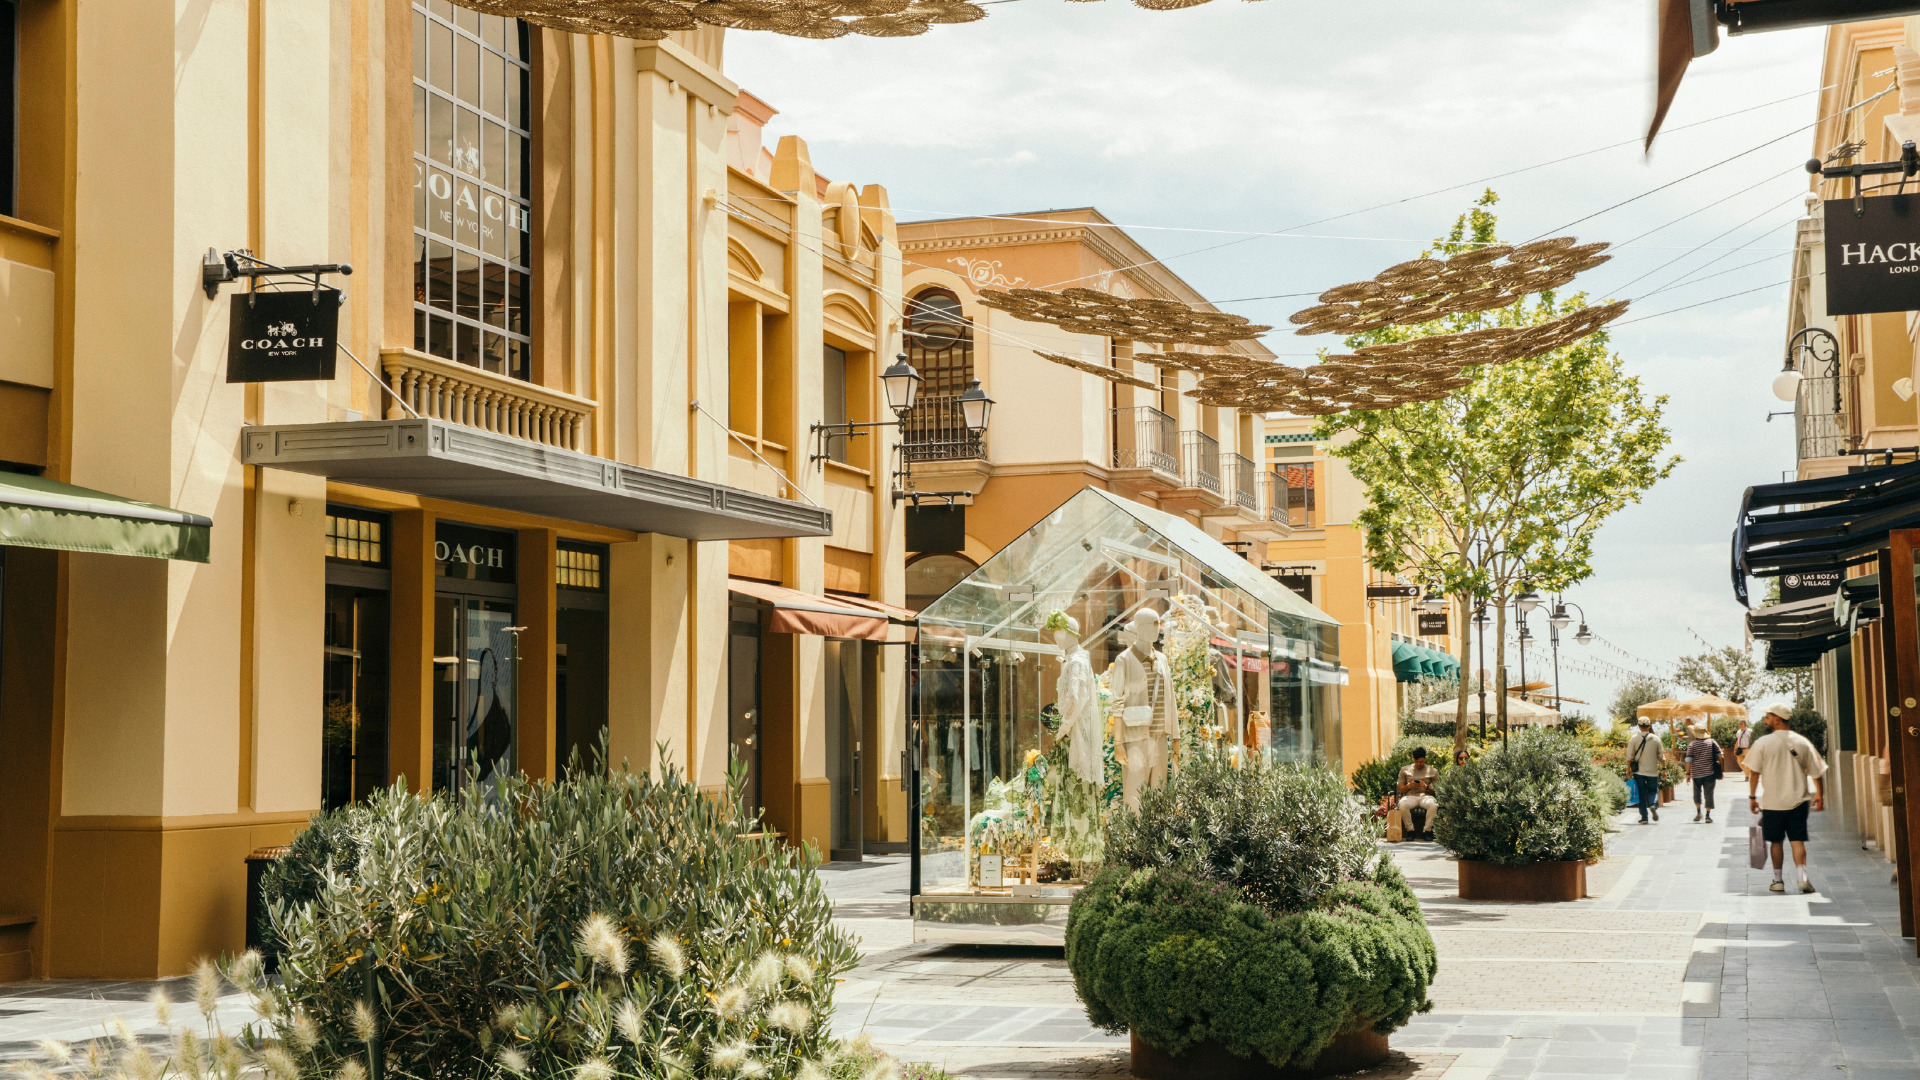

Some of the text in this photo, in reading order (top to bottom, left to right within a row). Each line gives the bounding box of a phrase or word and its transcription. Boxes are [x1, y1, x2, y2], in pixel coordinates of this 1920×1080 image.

[440, 209, 494, 239] NEW YORK
[1841, 242, 1920, 266] HACK
[1889, 265, 1920, 274] LOND
[241, 337, 324, 350] COACH
[435, 540, 504, 569] OACH
